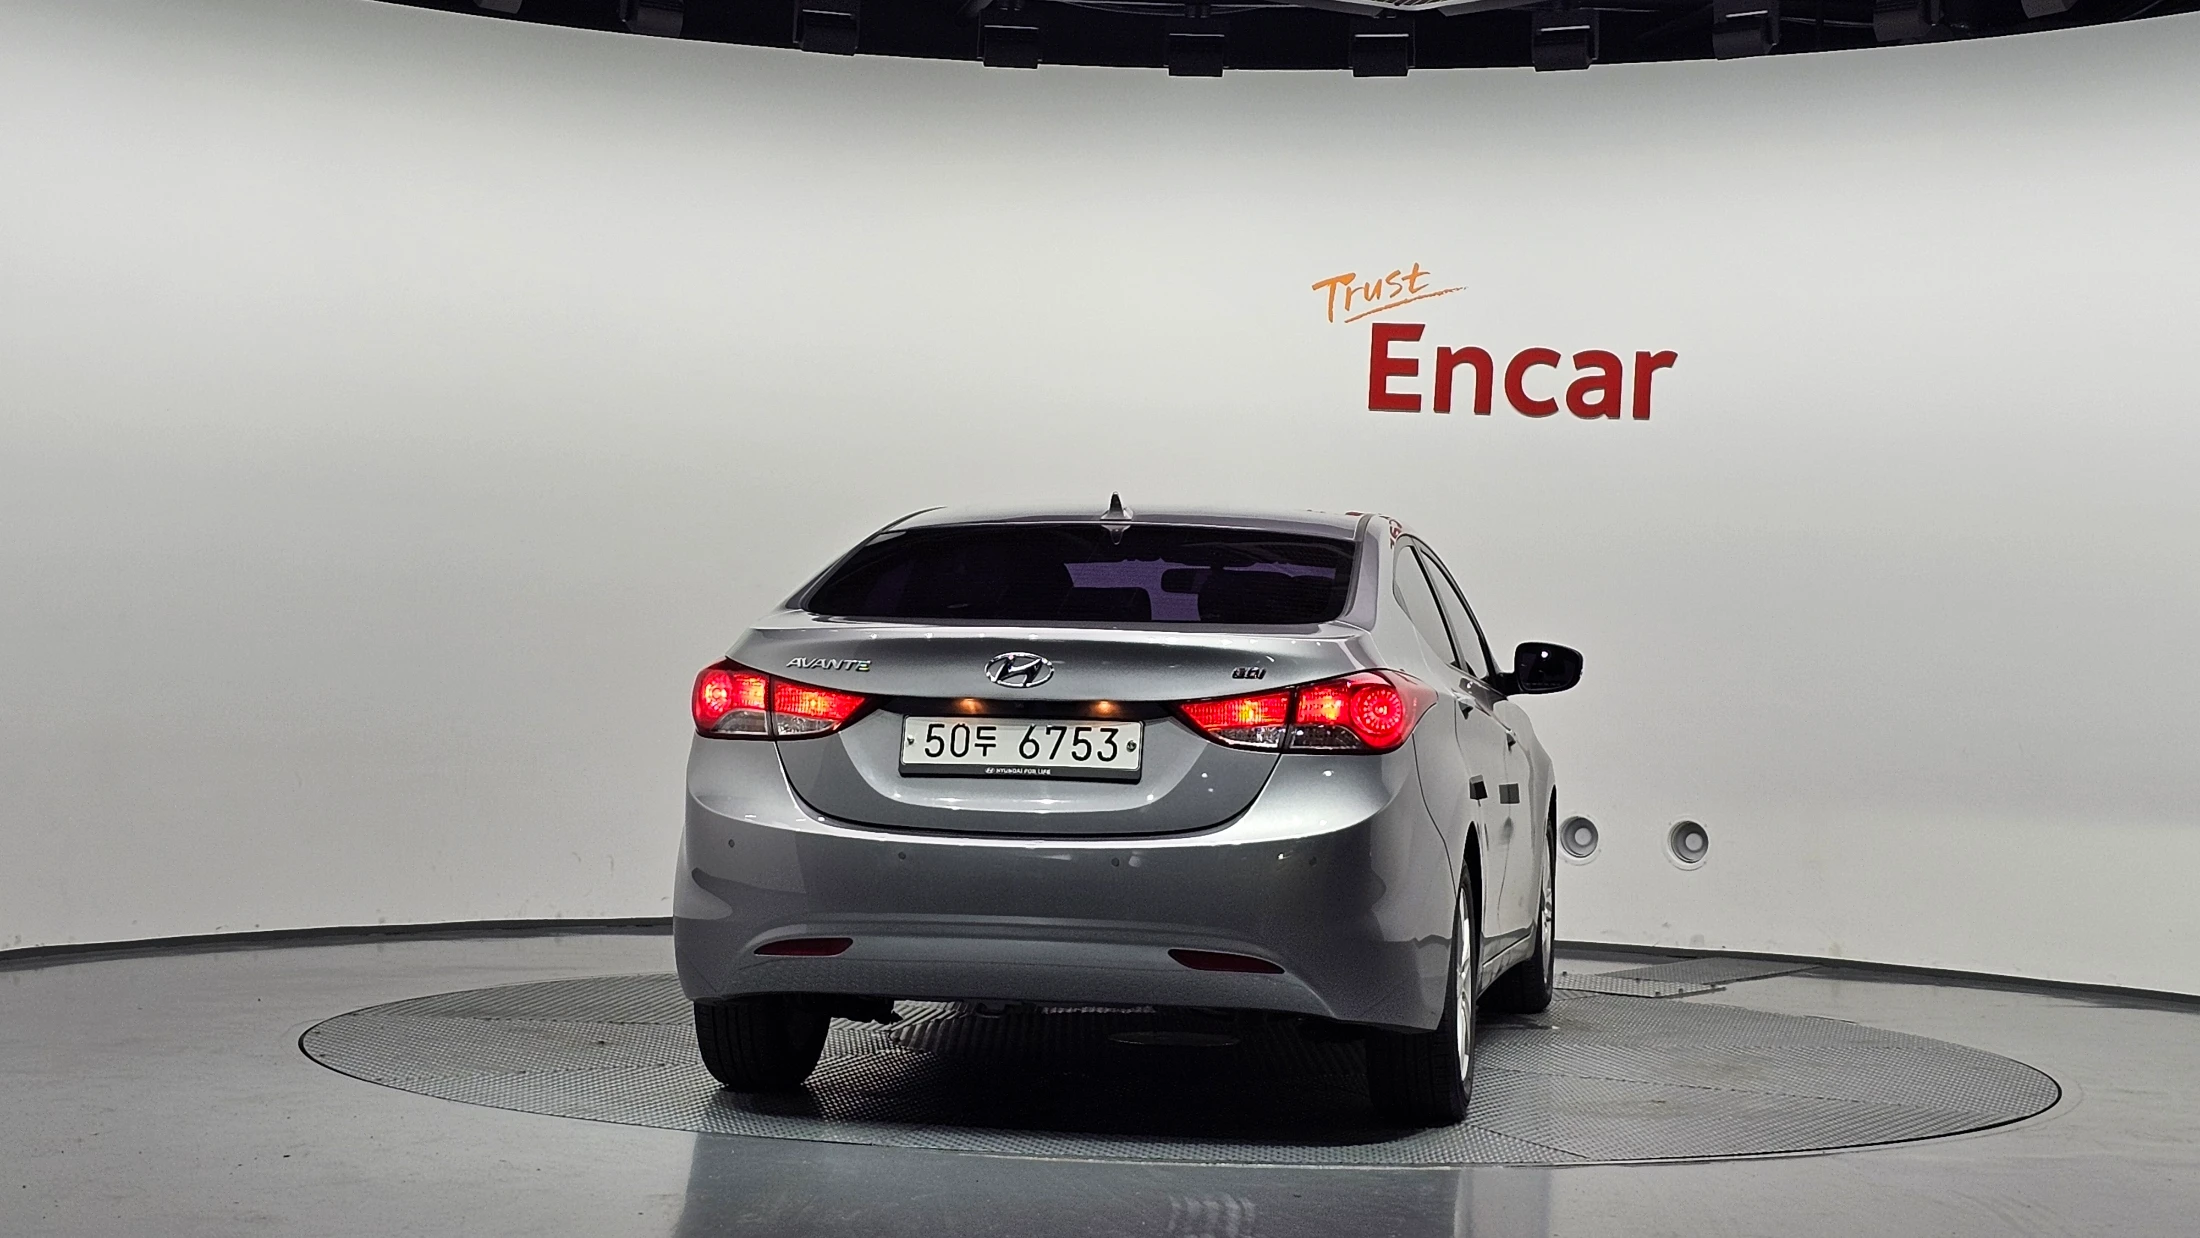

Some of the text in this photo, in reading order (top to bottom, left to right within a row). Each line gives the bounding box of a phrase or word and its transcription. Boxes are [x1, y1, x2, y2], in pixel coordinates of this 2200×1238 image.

[1312, 262, 1432, 323] Trust
[1368, 322, 1678, 420] Encar
[786, 657, 871, 671] AVANTE
[924, 723, 1119, 762] 50두 6753
